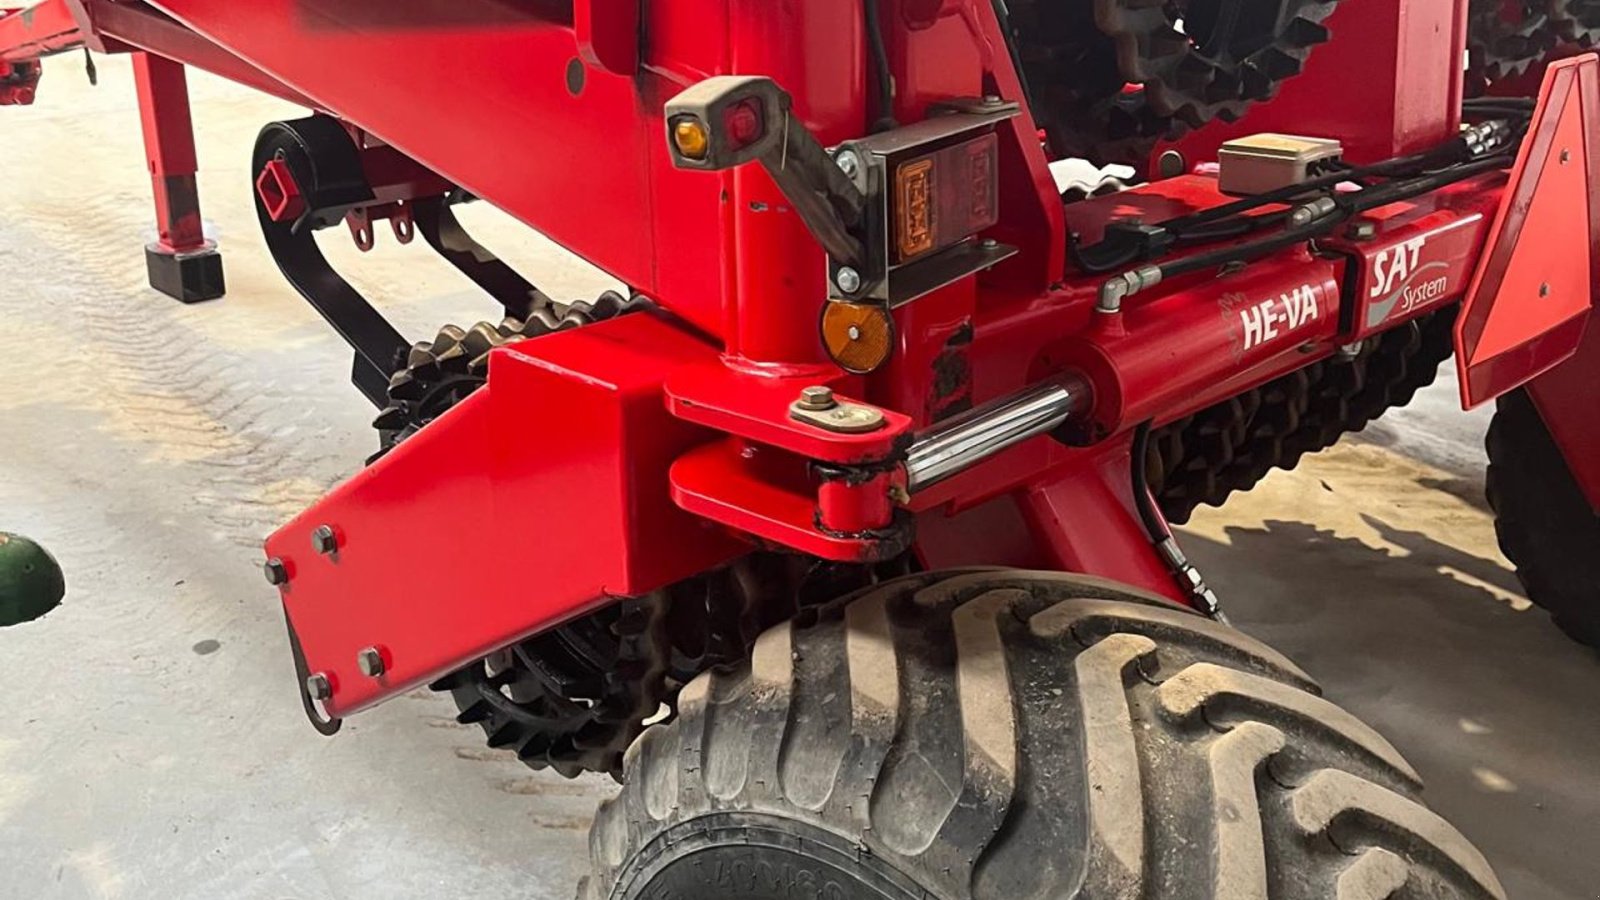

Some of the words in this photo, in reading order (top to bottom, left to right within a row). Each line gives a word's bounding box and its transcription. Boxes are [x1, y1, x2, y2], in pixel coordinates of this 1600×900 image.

[1370, 237, 1426, 298] SAT
[1401, 275, 1448, 310] System
[1240, 284, 1318, 350] HE-VA
